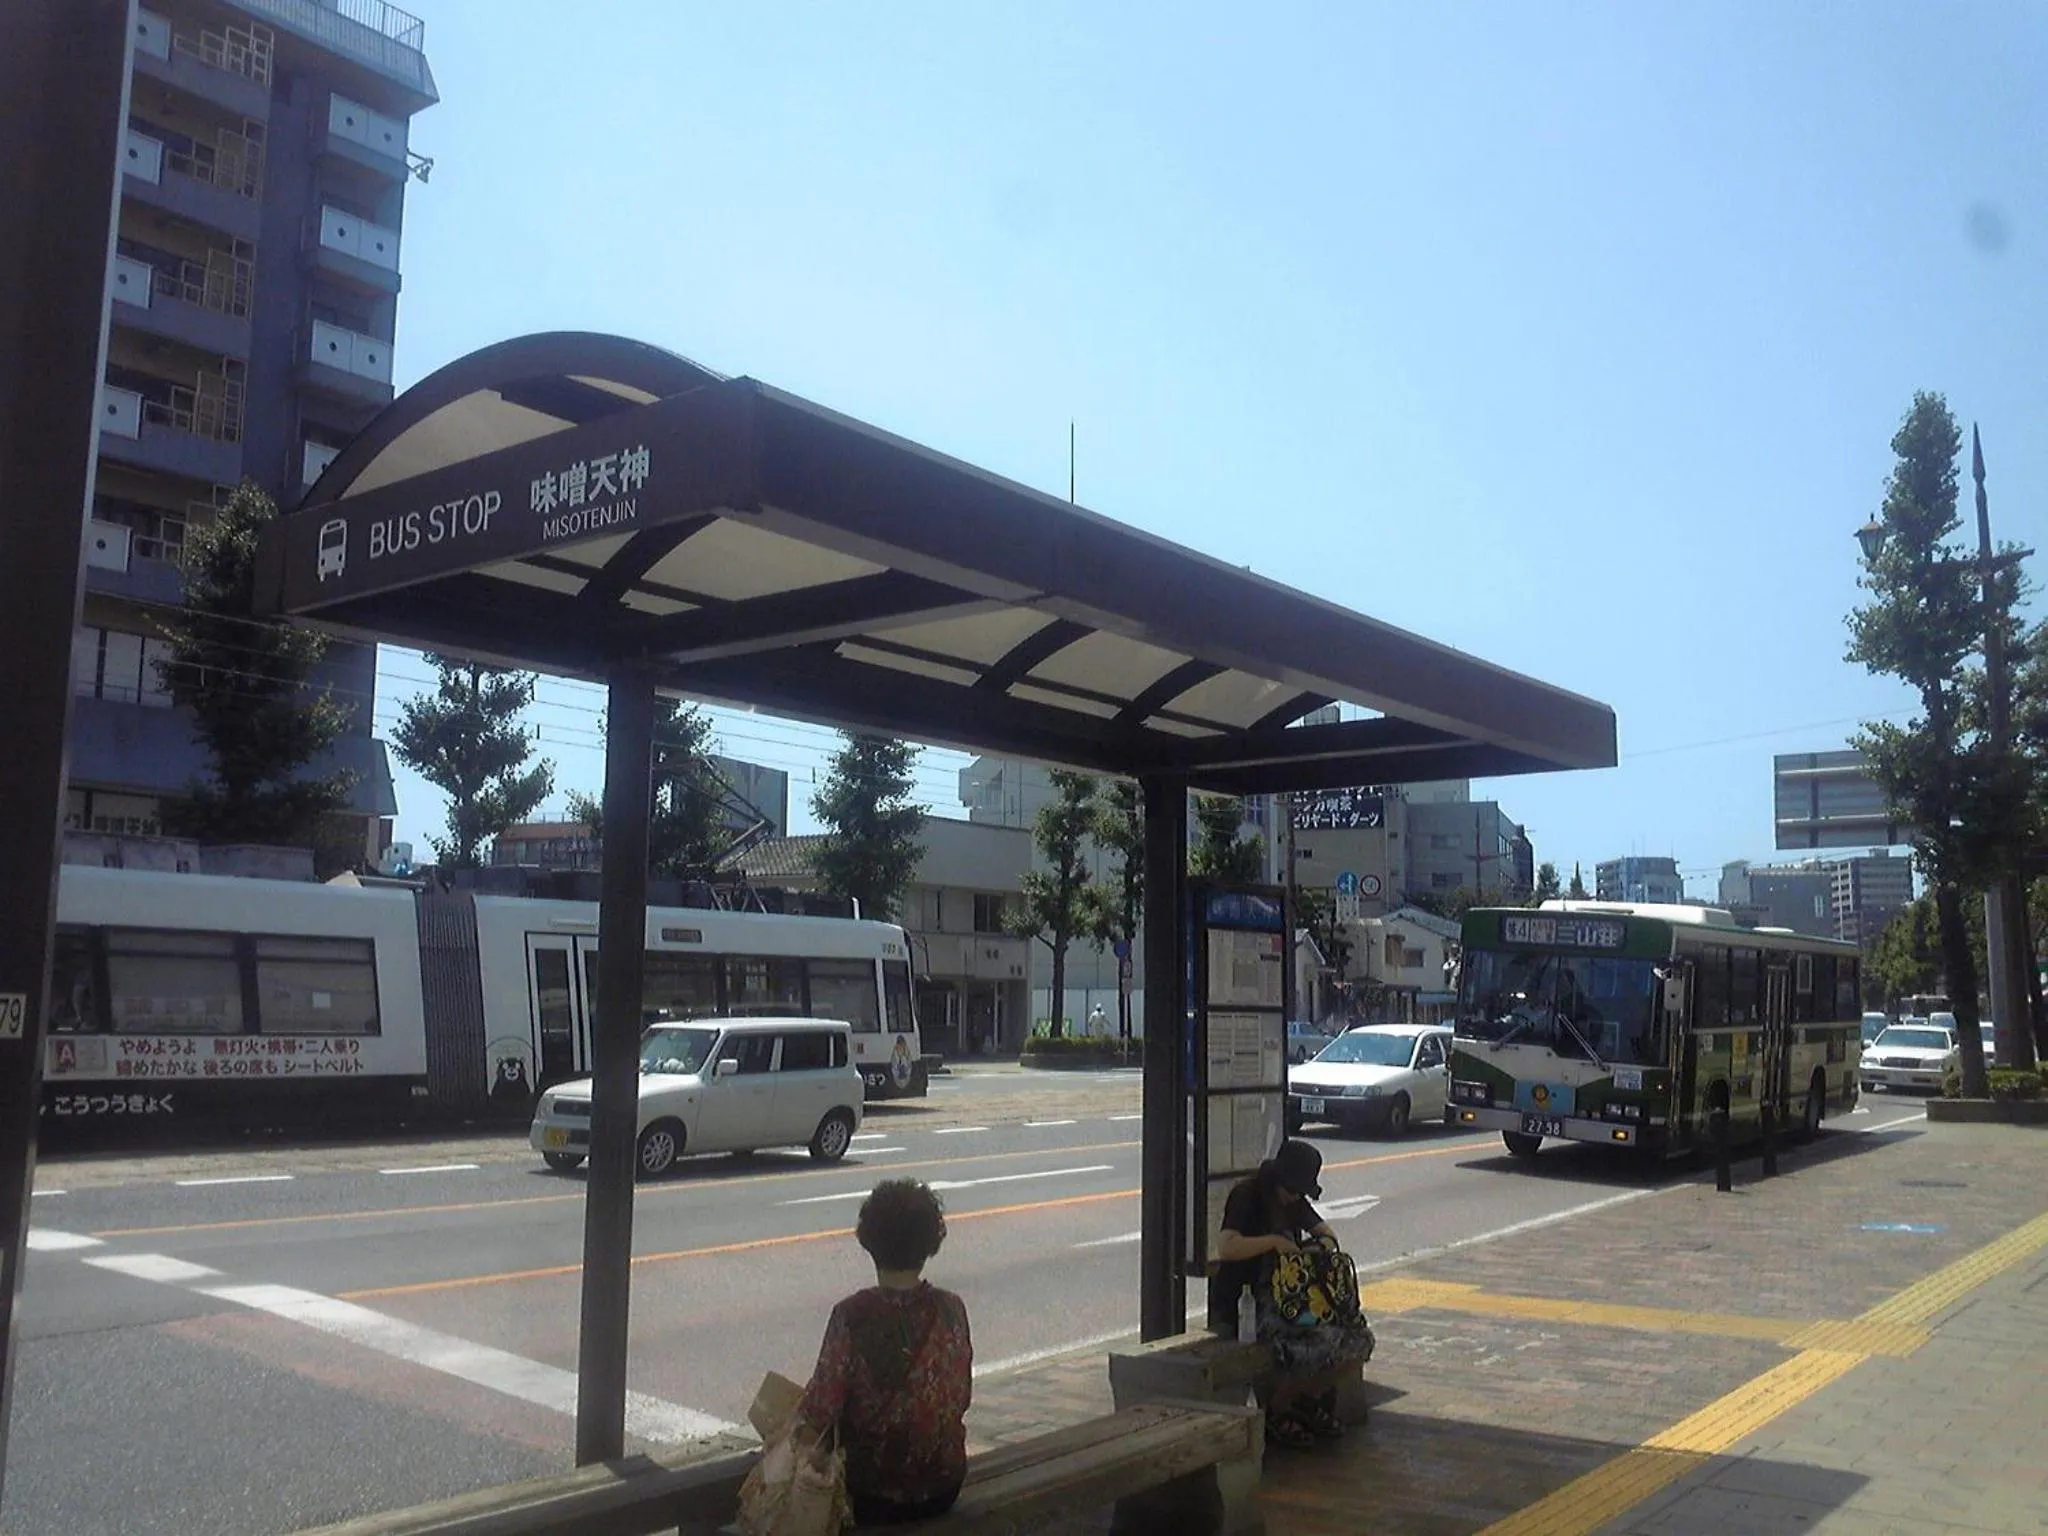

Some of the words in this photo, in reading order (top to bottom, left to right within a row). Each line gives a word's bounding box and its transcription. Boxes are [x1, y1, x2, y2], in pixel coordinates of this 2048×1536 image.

[530, 444, 651, 513] 味噌天神
[370, 513, 420, 559] BUS
[427, 490, 502, 545] STOP
[543, 498, 637, 541] MISOTENJIN
[119, 1038, 197, 1056] やめようよ
[283, 1057, 365, 1075] シートベルト
[40, 1094, 174, 1115] こうつうきょく
